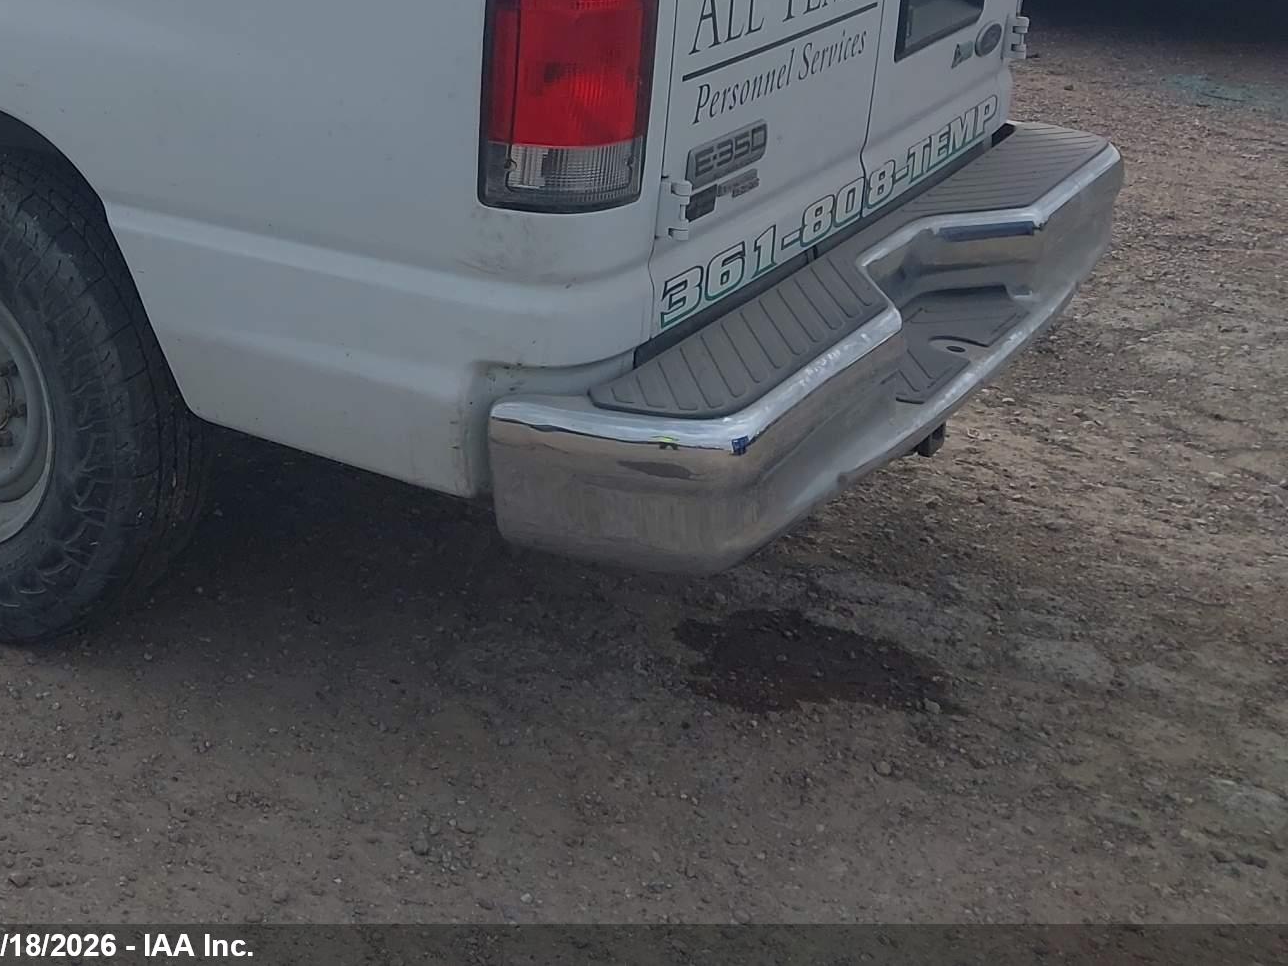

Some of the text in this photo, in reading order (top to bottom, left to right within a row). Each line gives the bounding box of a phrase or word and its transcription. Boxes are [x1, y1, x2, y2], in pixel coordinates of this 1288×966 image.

[692, 26, 867, 125] Personnel Services
[659, 94, 999, 329] 361-808-TEMP
